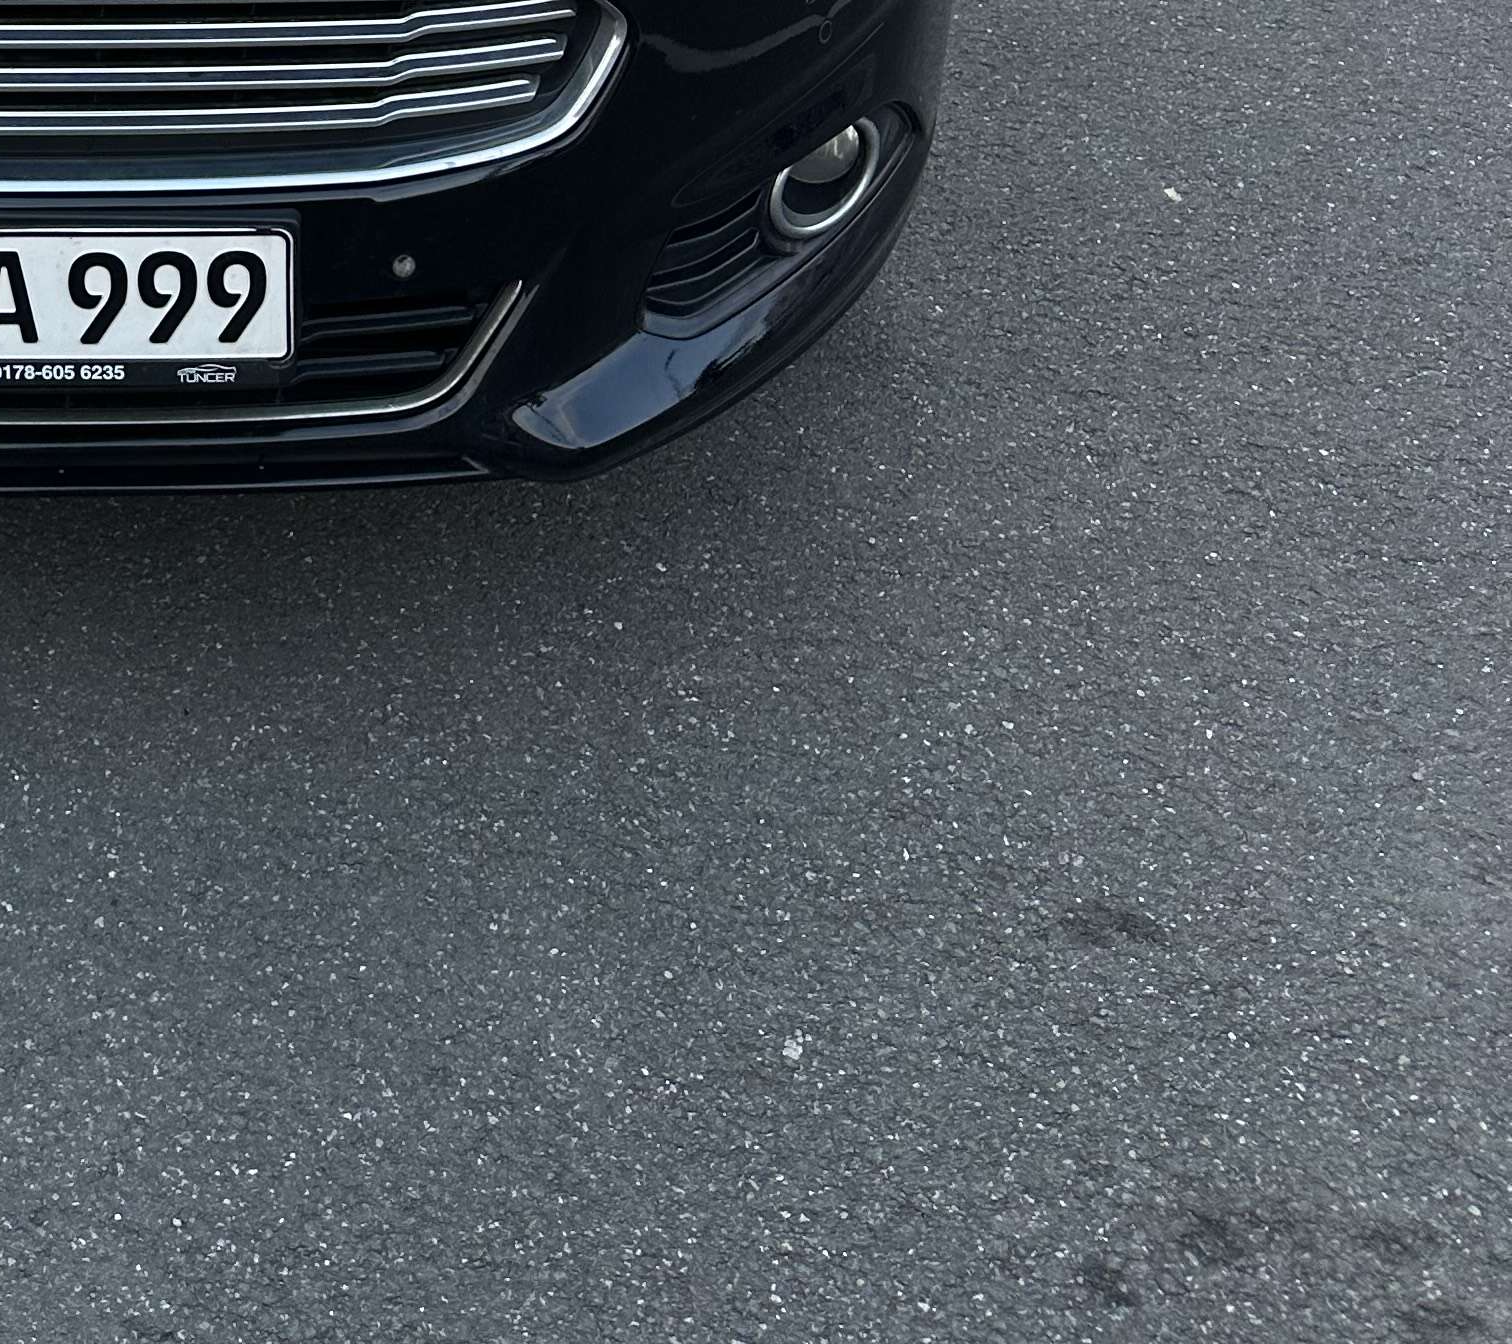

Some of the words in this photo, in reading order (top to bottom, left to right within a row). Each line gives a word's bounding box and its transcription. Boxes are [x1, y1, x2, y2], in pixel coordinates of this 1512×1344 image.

[68, 250, 267, 344] 999
[80, 364, 125, 380] 6235
[179, 372, 236, 383] TUNCER
